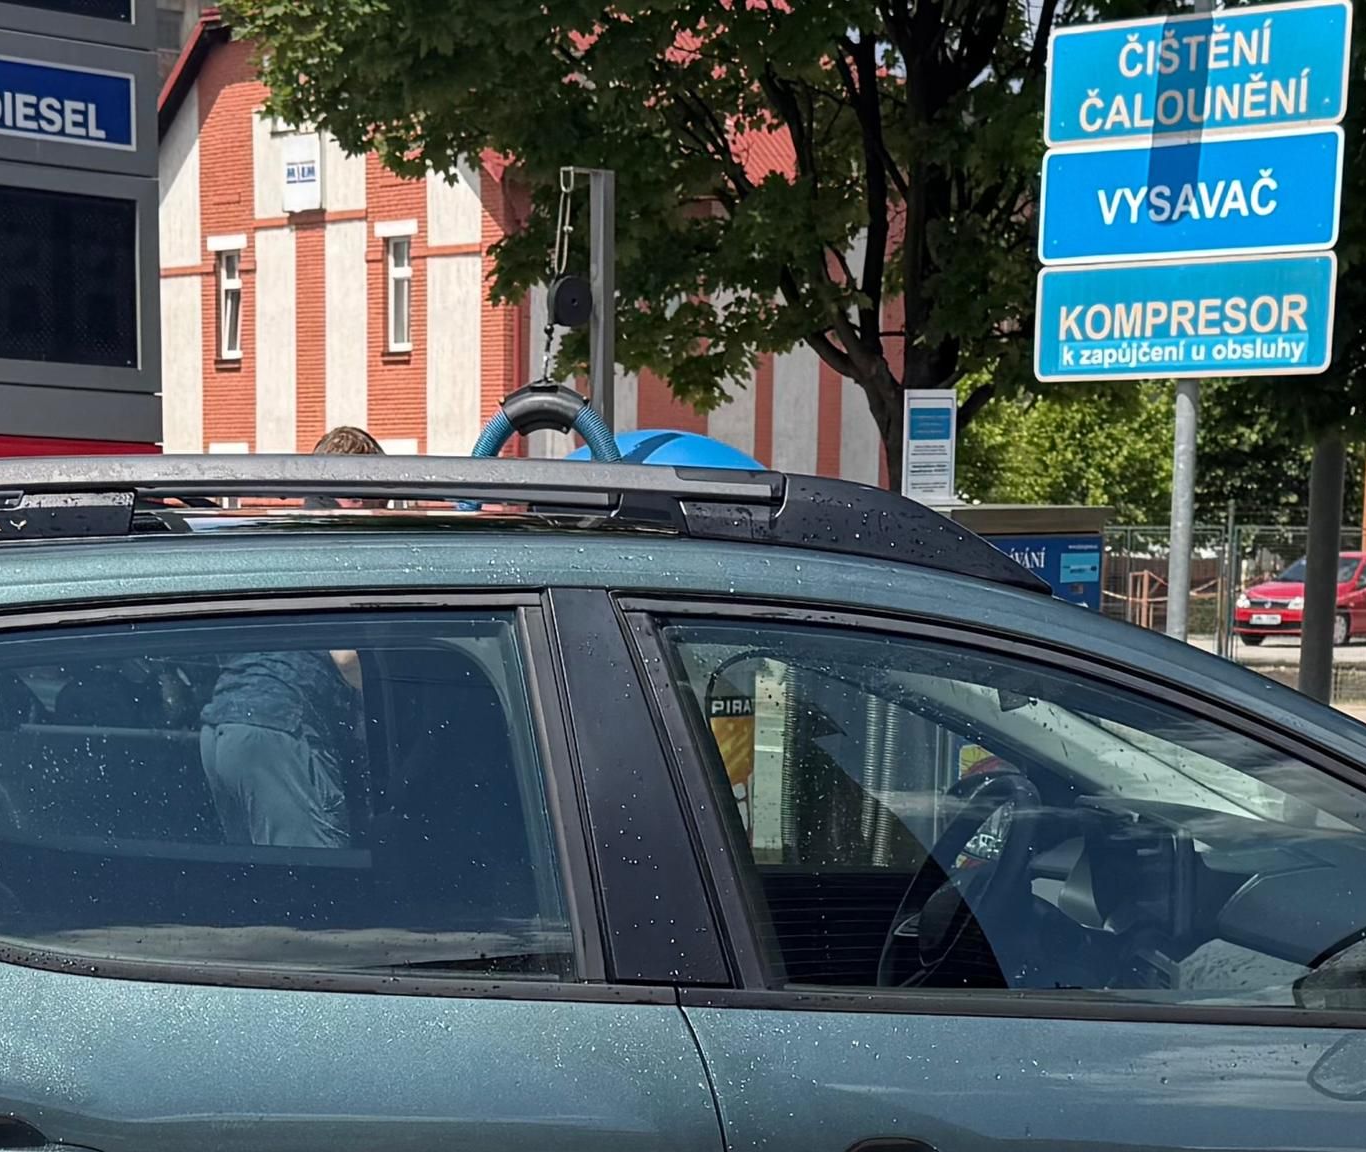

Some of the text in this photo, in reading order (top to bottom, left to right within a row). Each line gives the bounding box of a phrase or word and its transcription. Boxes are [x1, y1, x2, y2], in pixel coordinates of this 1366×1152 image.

[1119, 18, 1272, 77] ČIŠTĚNÍ
[1079, 67, 1311, 132] ČALOUNĚNÍ
[1097, 168, 1278, 225] VYSAVAČ
[1059, 294, 1308, 341] KOMPRESOR
[1062, 337, 1305, 368] k zapůjčení u obsluhy
